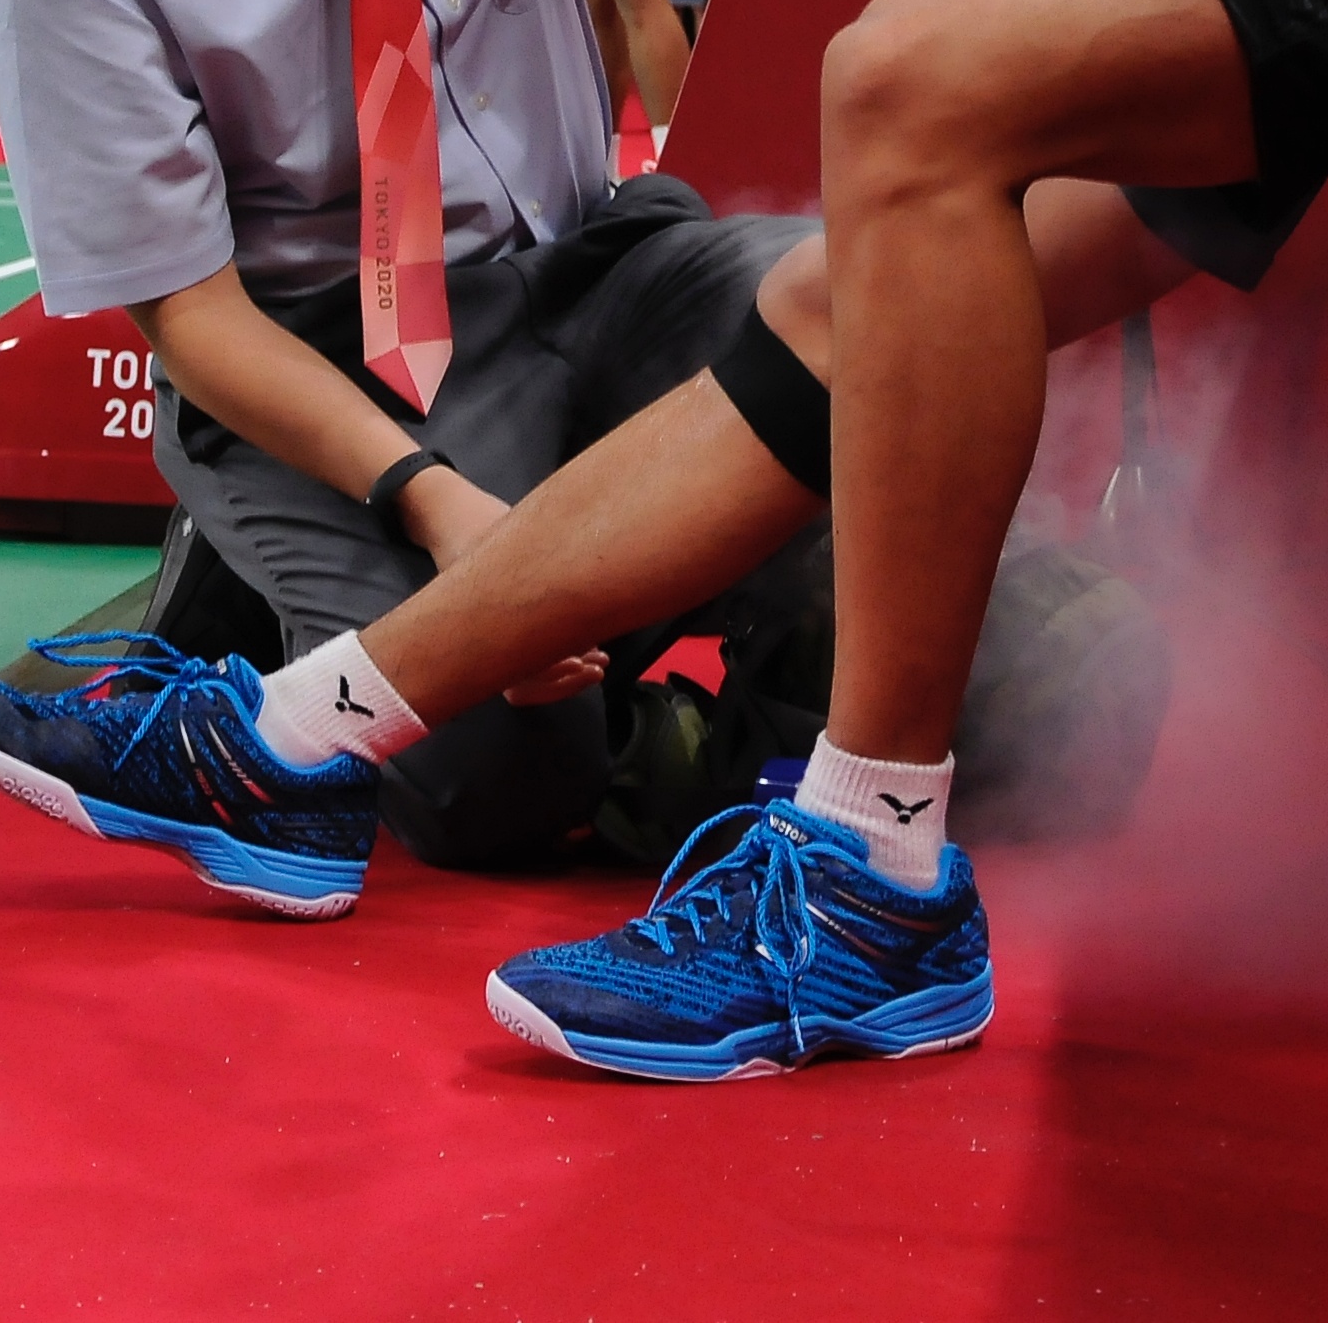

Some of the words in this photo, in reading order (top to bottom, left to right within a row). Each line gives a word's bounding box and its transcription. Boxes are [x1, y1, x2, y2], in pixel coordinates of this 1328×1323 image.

[374, 177, 390, 250] TOKYO
[376, 257, 393, 311] 2020
[86, 348, 153, 391] TO
